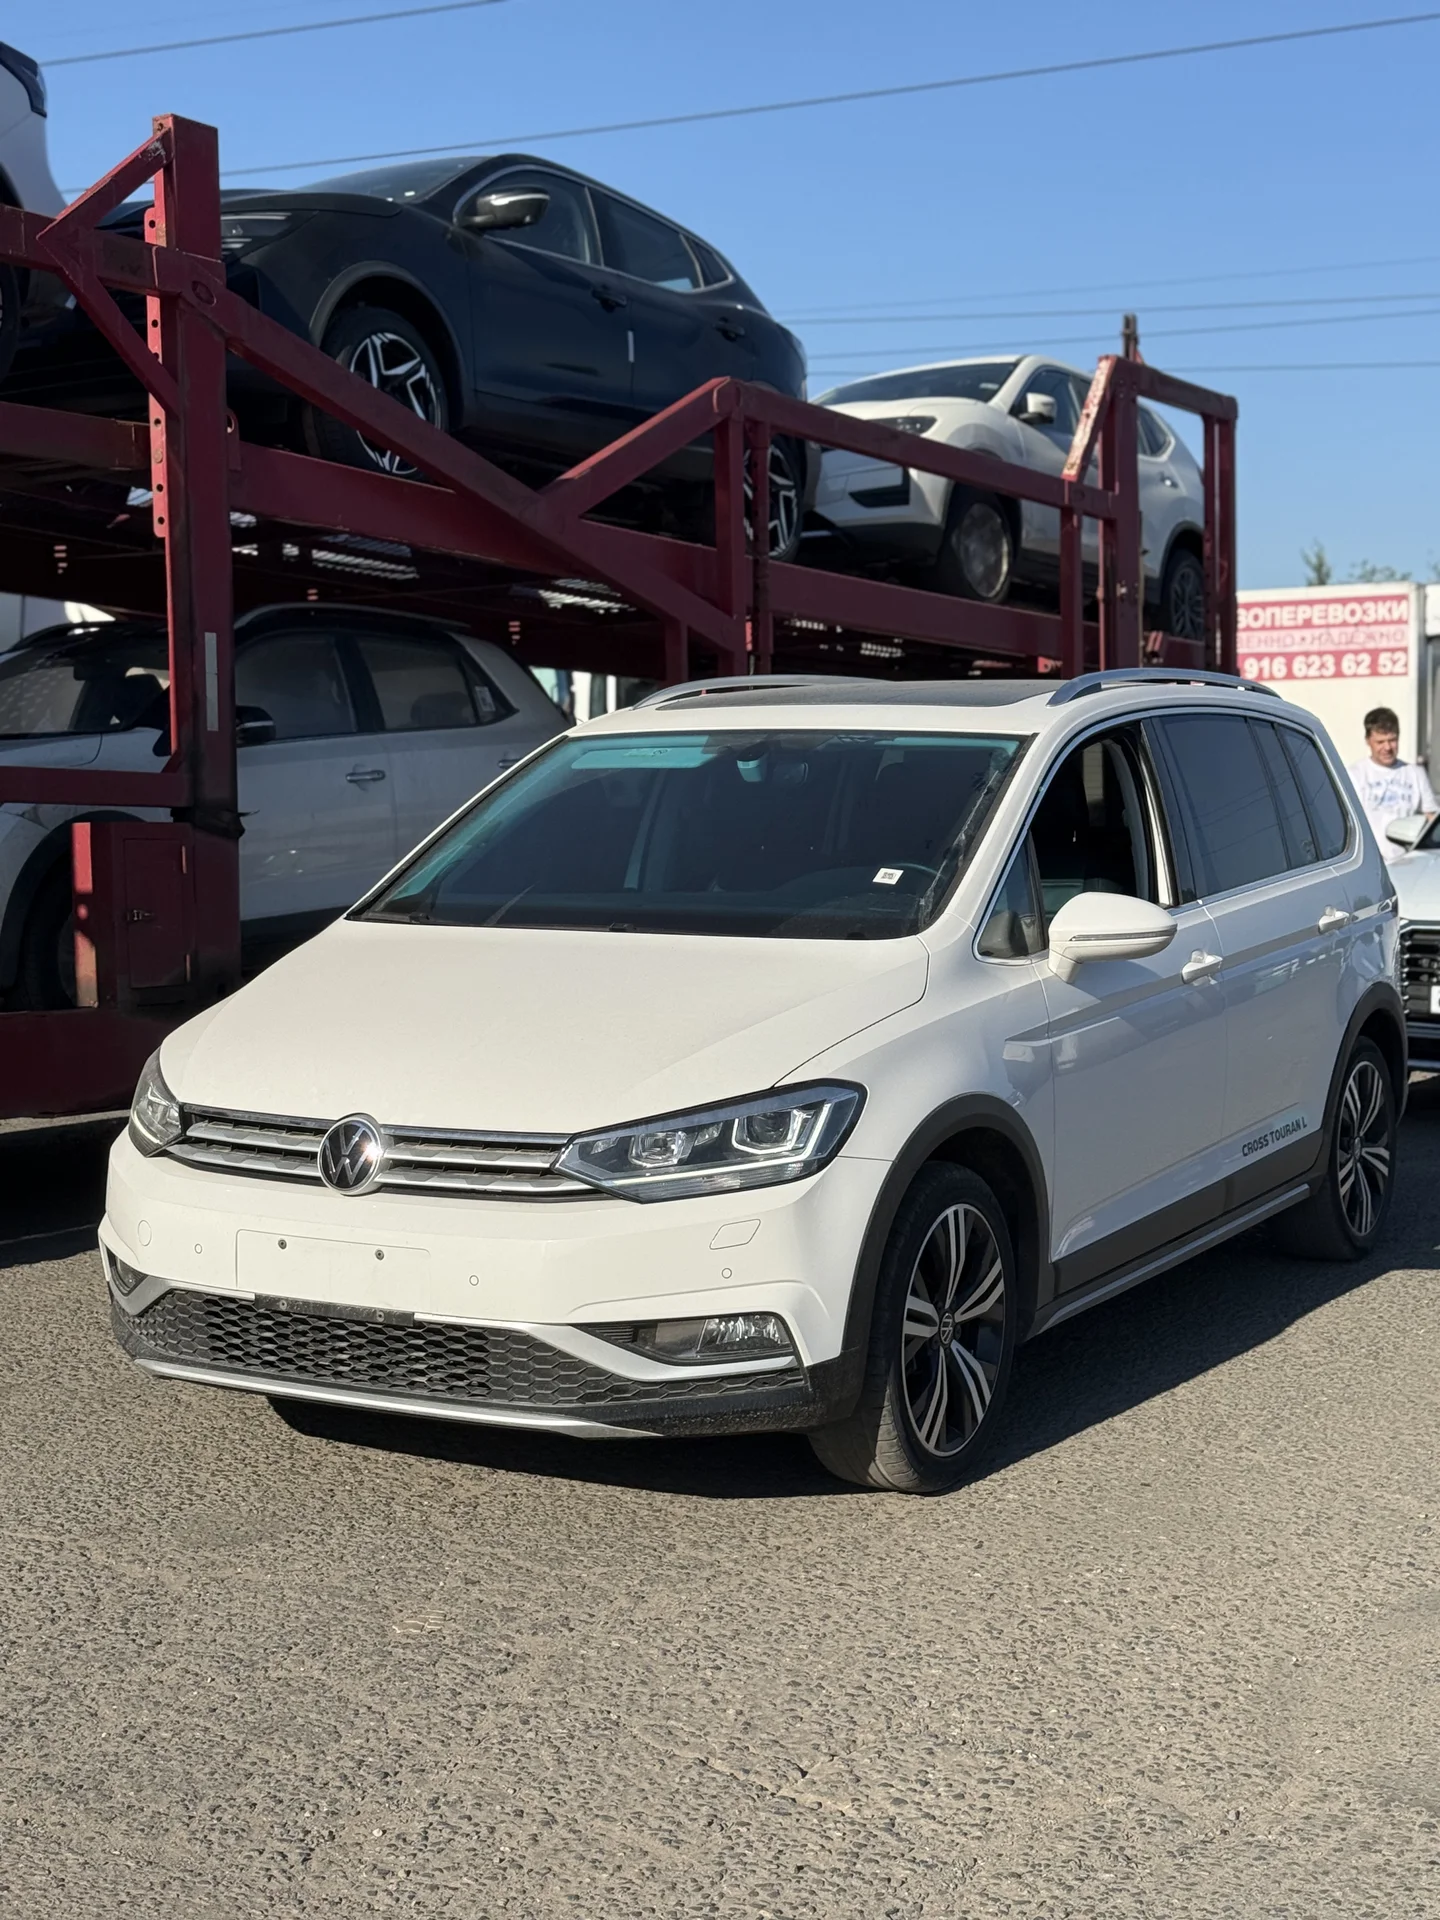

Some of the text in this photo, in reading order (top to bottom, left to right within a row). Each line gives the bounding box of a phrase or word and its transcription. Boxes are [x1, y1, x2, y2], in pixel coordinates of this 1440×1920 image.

[1243, 651, 1408, 679] 916 623 62 52
[320, 1119, 381, 1191] VW
[1241, 1116, 1307, 1157] CROSS TOURAN L
